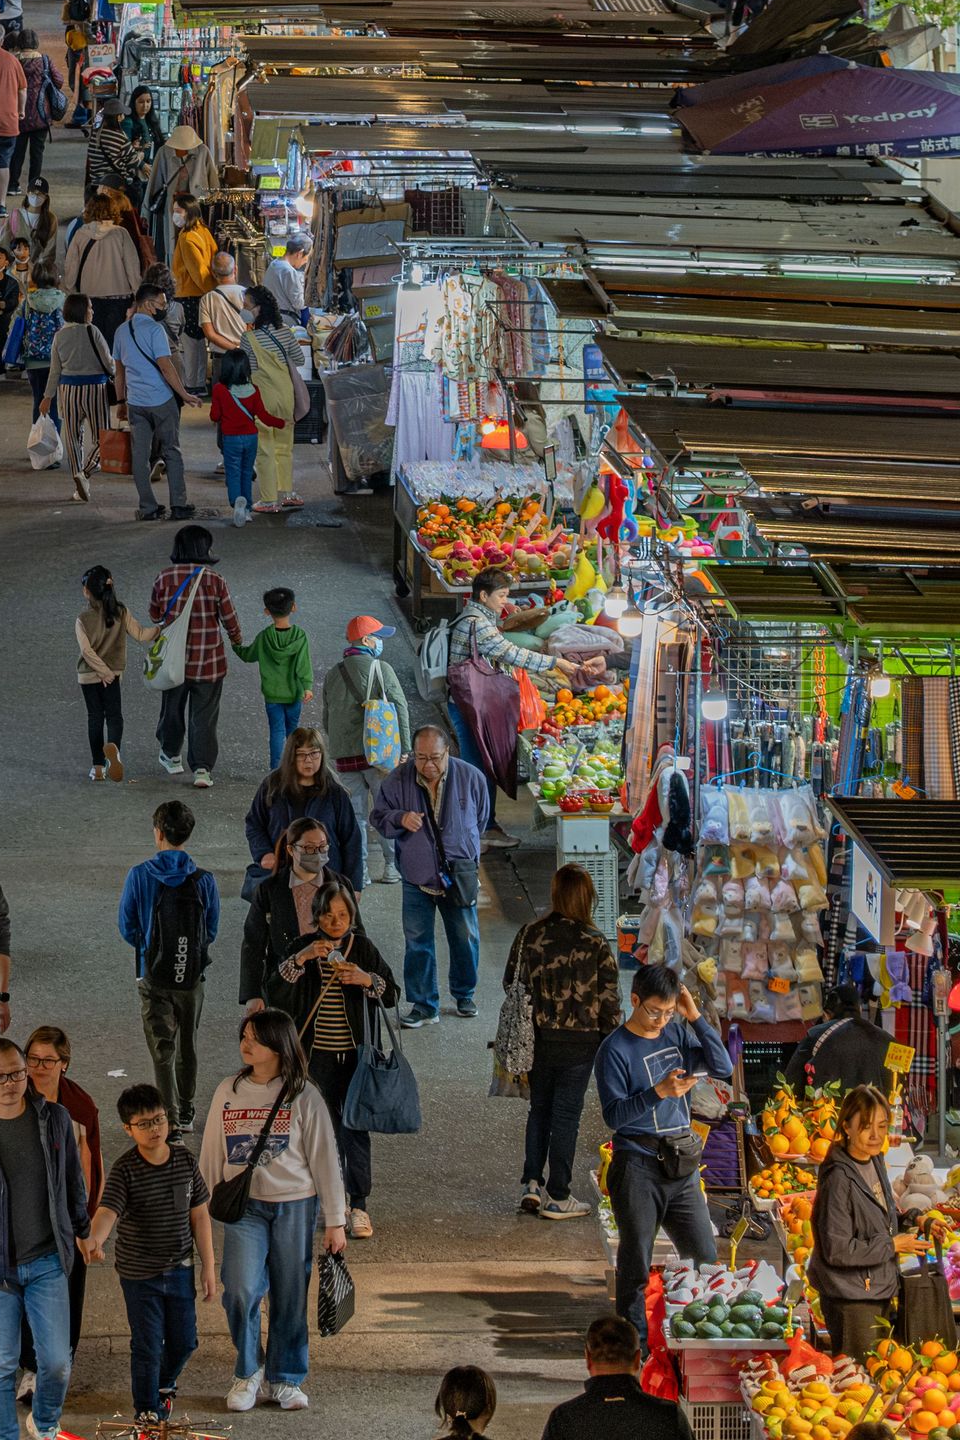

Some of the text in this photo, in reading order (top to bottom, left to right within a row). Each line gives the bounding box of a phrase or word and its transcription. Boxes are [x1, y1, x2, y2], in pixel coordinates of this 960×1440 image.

[843, 103, 938, 124] Yedpay
[174, 936, 188, 983] adidas
[224, 1109, 290, 1120] HOT WHELS
